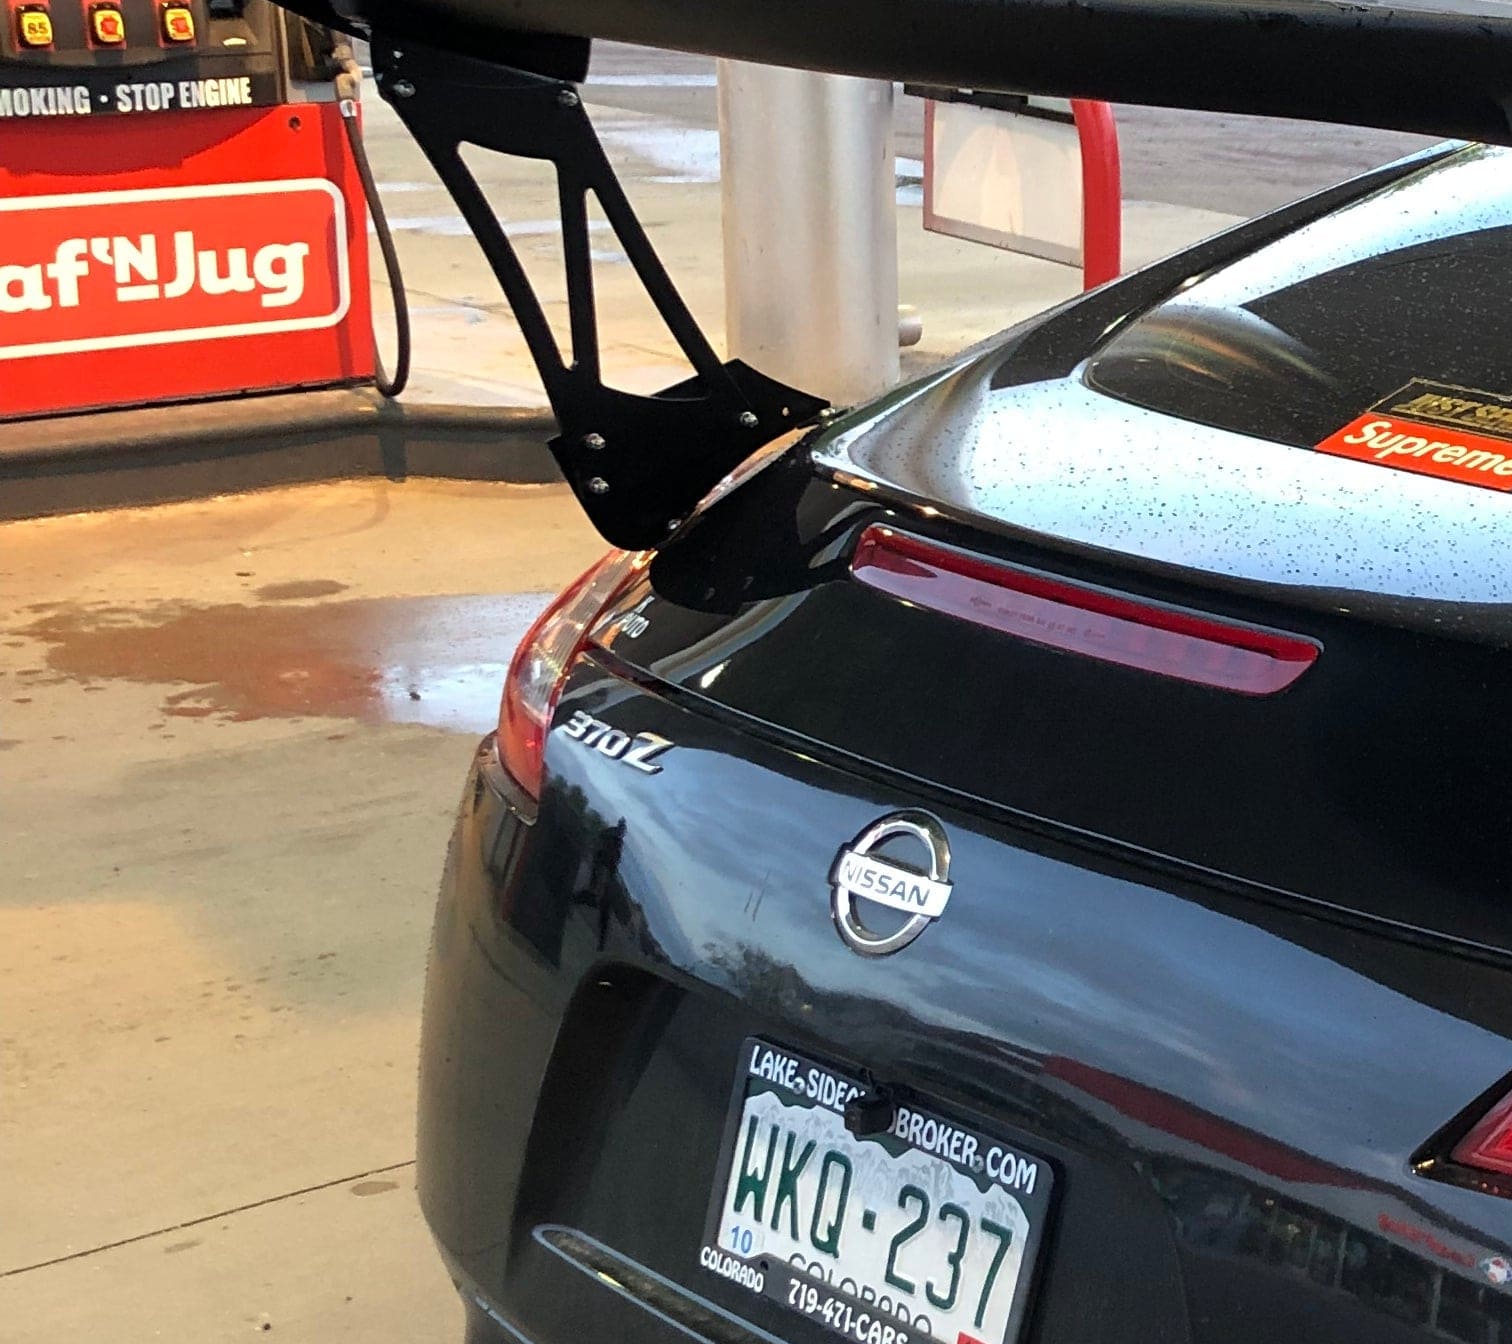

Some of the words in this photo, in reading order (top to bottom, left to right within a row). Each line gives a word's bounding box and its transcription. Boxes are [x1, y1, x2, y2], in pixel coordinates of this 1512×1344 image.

[27, 21, 48, 35] 85
[115, 82, 176, 113] STOP
[179, 76, 253, 109] ENGINE
[563, 709, 676, 775] 370Z
[843, 859, 931, 907] NISSAN
[730, 1225, 753, 1255] 10
[701, 1246, 765, 1294] COLORADO
